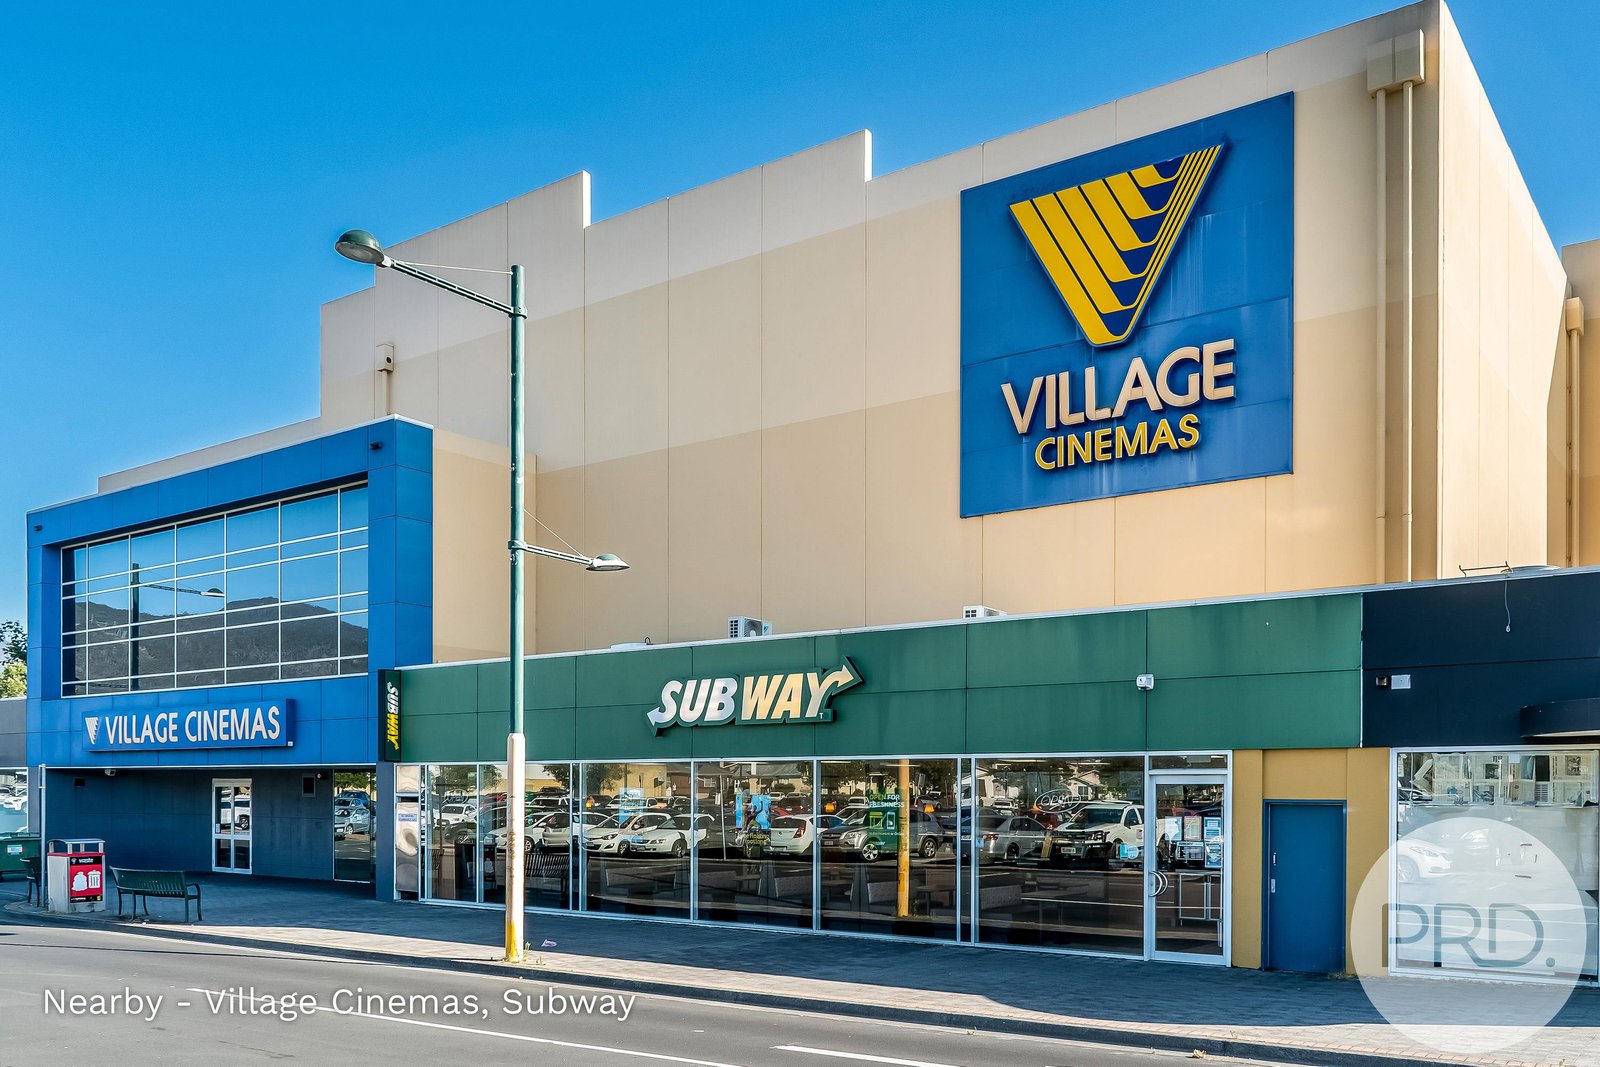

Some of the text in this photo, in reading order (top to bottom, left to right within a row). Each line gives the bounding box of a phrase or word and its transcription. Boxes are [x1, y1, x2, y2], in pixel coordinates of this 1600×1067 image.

[1000, 338, 1235, 435] VILLAGE
[1034, 413, 1200, 471] CINEMAS
[105, 705, 281, 745] VILLAGE CINEMAS
[386, 682, 400, 750] SUBWAY
[647, 664, 854, 727] SUBWAY
